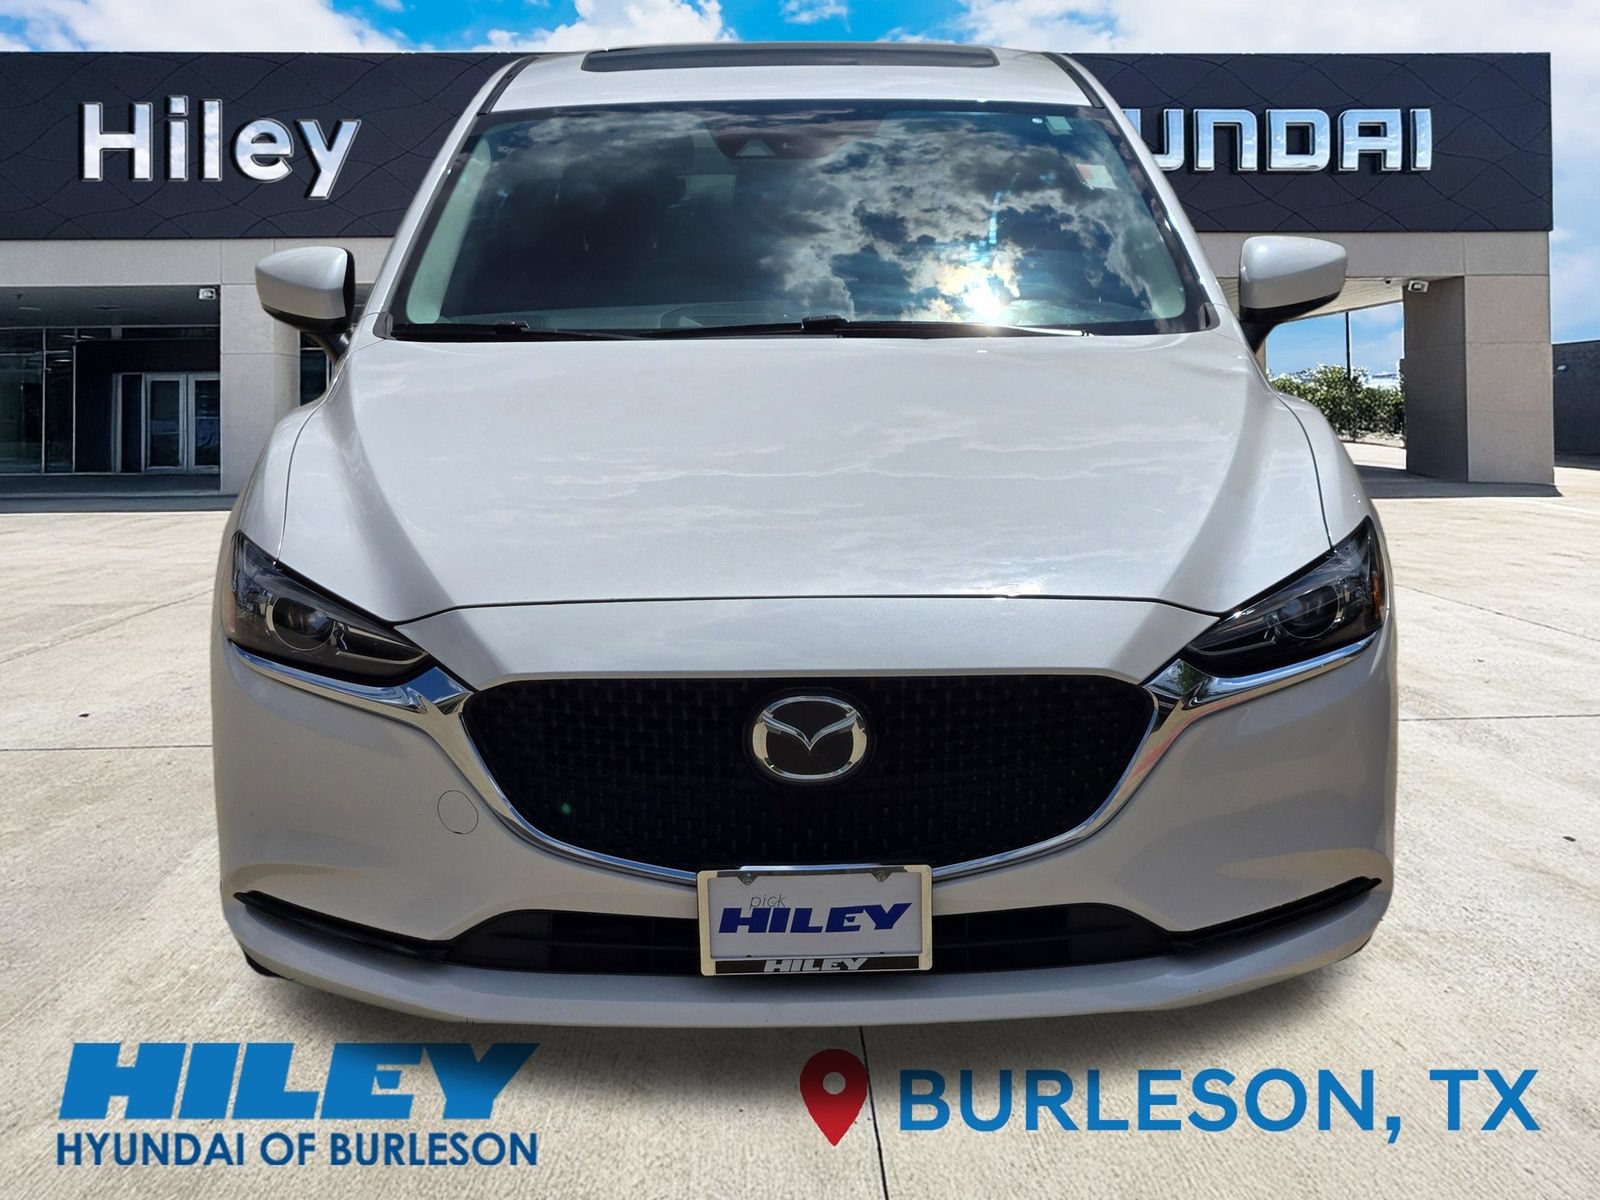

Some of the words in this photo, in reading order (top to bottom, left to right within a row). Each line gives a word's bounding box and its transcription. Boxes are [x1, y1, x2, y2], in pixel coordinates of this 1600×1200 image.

[81, 95, 361, 199] Hiley
[749, 893, 787, 911] pick
[718, 902, 913, 934] HILEY
[764, 957, 869, 973] HILEY
